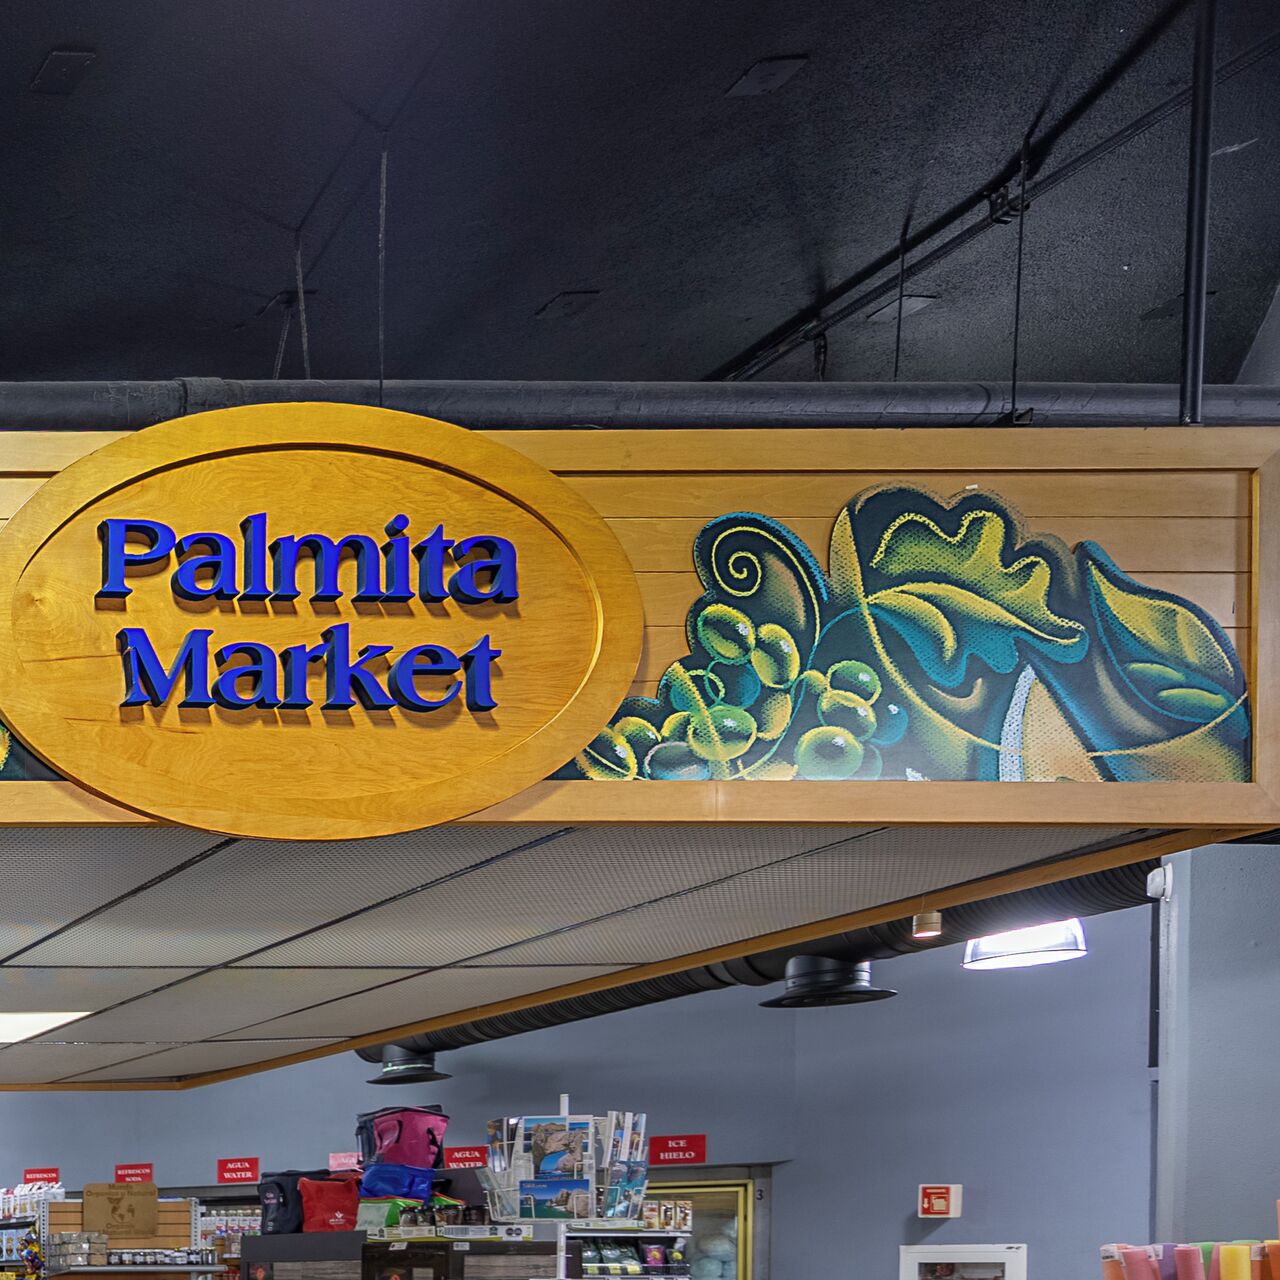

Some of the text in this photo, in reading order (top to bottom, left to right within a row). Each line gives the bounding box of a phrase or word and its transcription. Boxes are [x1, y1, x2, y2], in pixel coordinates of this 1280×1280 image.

[94, 512, 520, 604] Palmita
[117, 621, 503, 714] Market
[667, 1139, 687, 1148] ICE
[452, 1151, 480, 1159] AGUA
[659, 1151, 695, 1160] HIELO
[223, 1171, 253, 1179] WATER
[756, 1189, 764, 1200] 3
